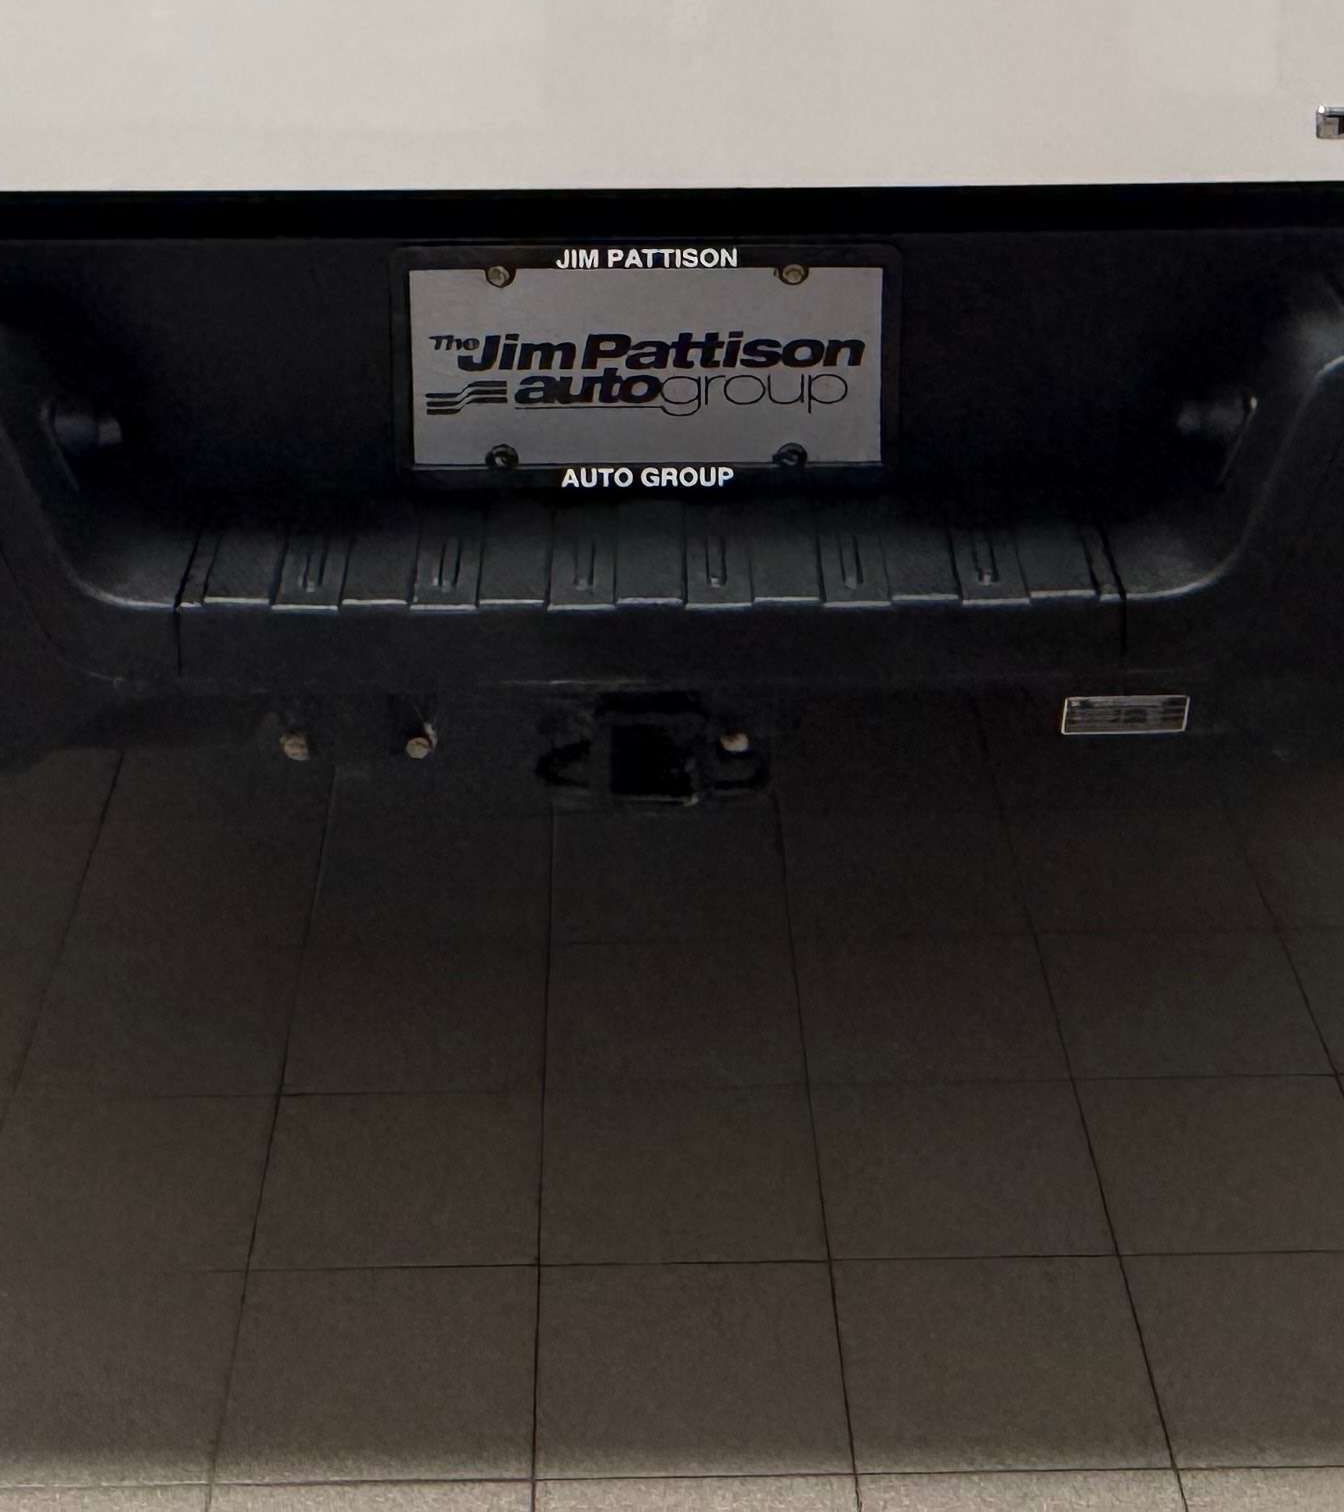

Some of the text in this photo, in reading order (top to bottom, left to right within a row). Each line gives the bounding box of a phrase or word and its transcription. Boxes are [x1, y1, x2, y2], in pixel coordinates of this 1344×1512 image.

[556, 247, 739, 269] JIM PATTISON
[428, 330, 866, 372] The Jim Pattison
[561, 466, 735, 488] AUTO GROUP
